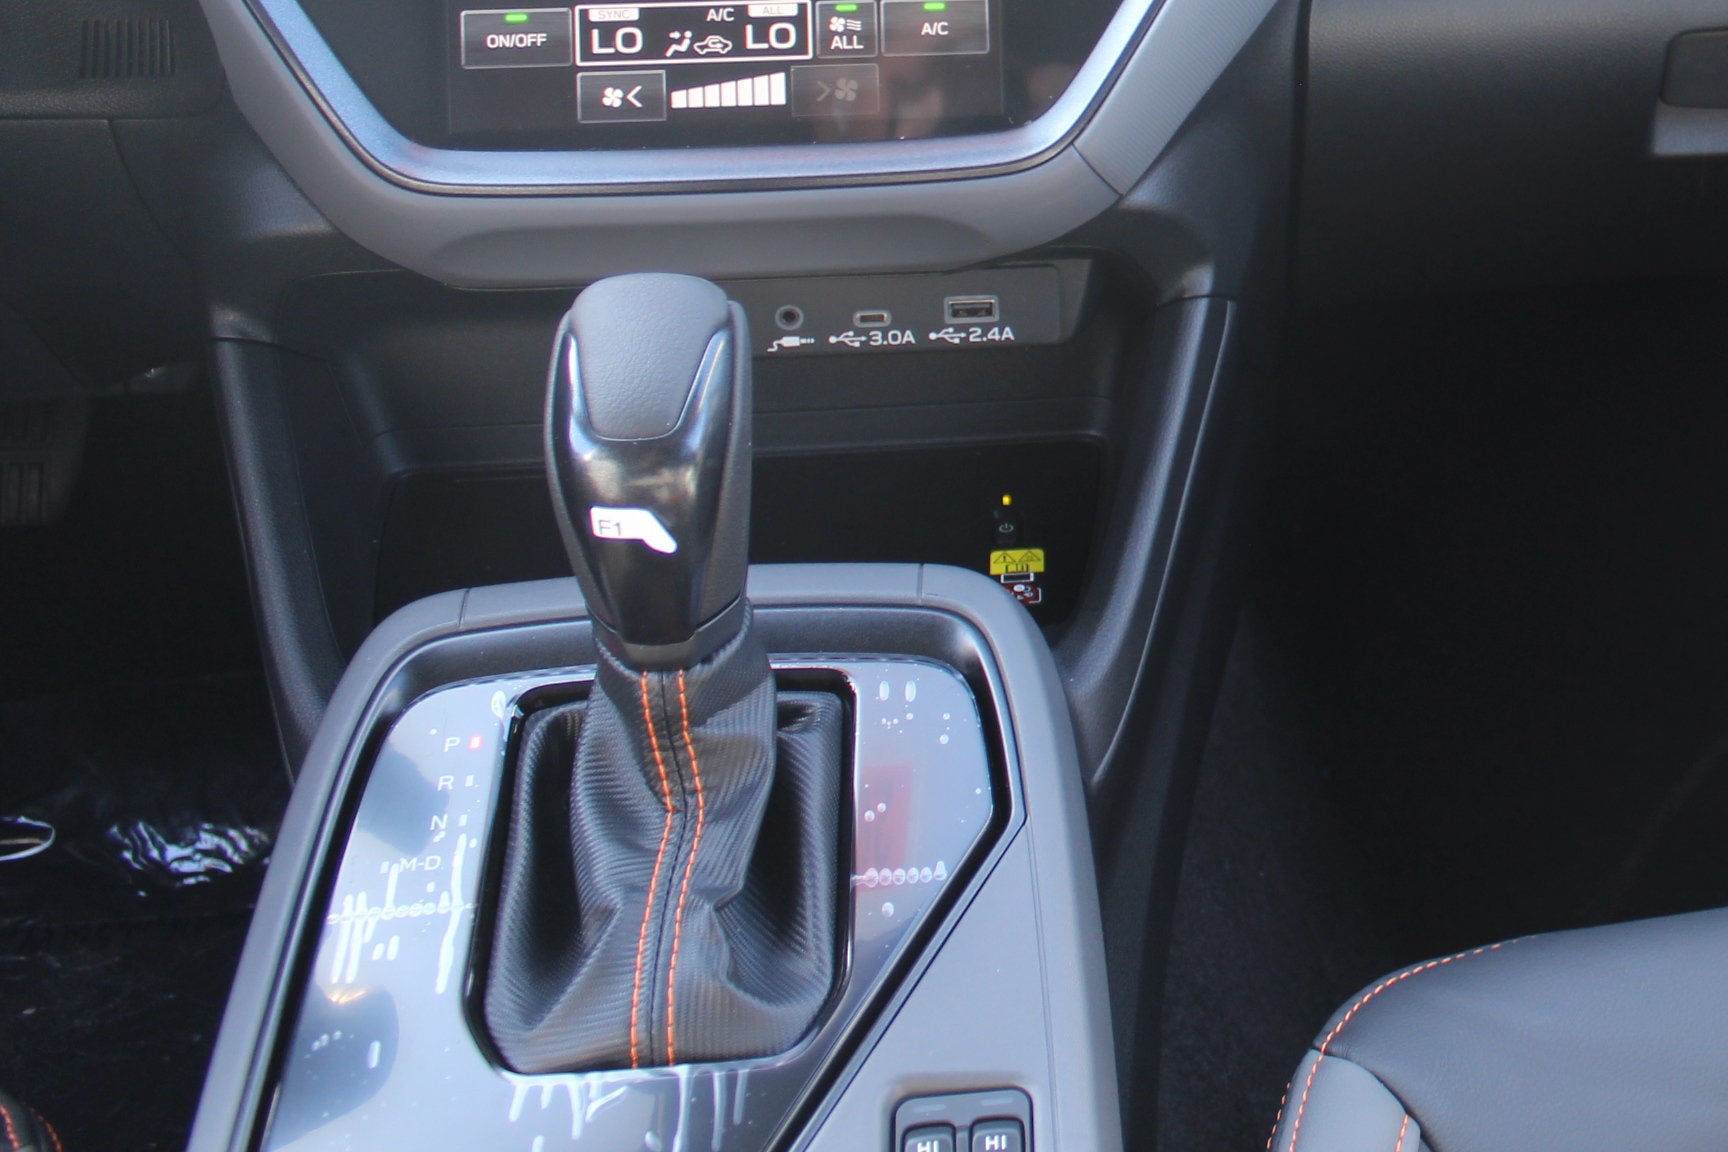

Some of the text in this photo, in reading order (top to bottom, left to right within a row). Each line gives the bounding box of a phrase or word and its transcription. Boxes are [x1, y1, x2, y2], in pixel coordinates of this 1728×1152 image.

[597, 9, 630, 21] SYNC
[706, 7, 735, 22] A/C
[762, 5, 785, 16] ALL
[745, 22, 796, 50] LO
[921, 21, 949, 36] A/C
[486, 32, 548, 49] ON/OFF
[591, 27, 643, 54] LO
[831, 35, 864, 50] ALL
[869, 330, 916, 345] 3.0A
[969, 327, 1015, 343] 2.4A
[598, 520, 623, 537] F1
[444, 737, 460, 752] P
[437, 775, 455, 791] R
[430, 814, 448, 831] N
[985, 1135, 1008, 1151] HI
